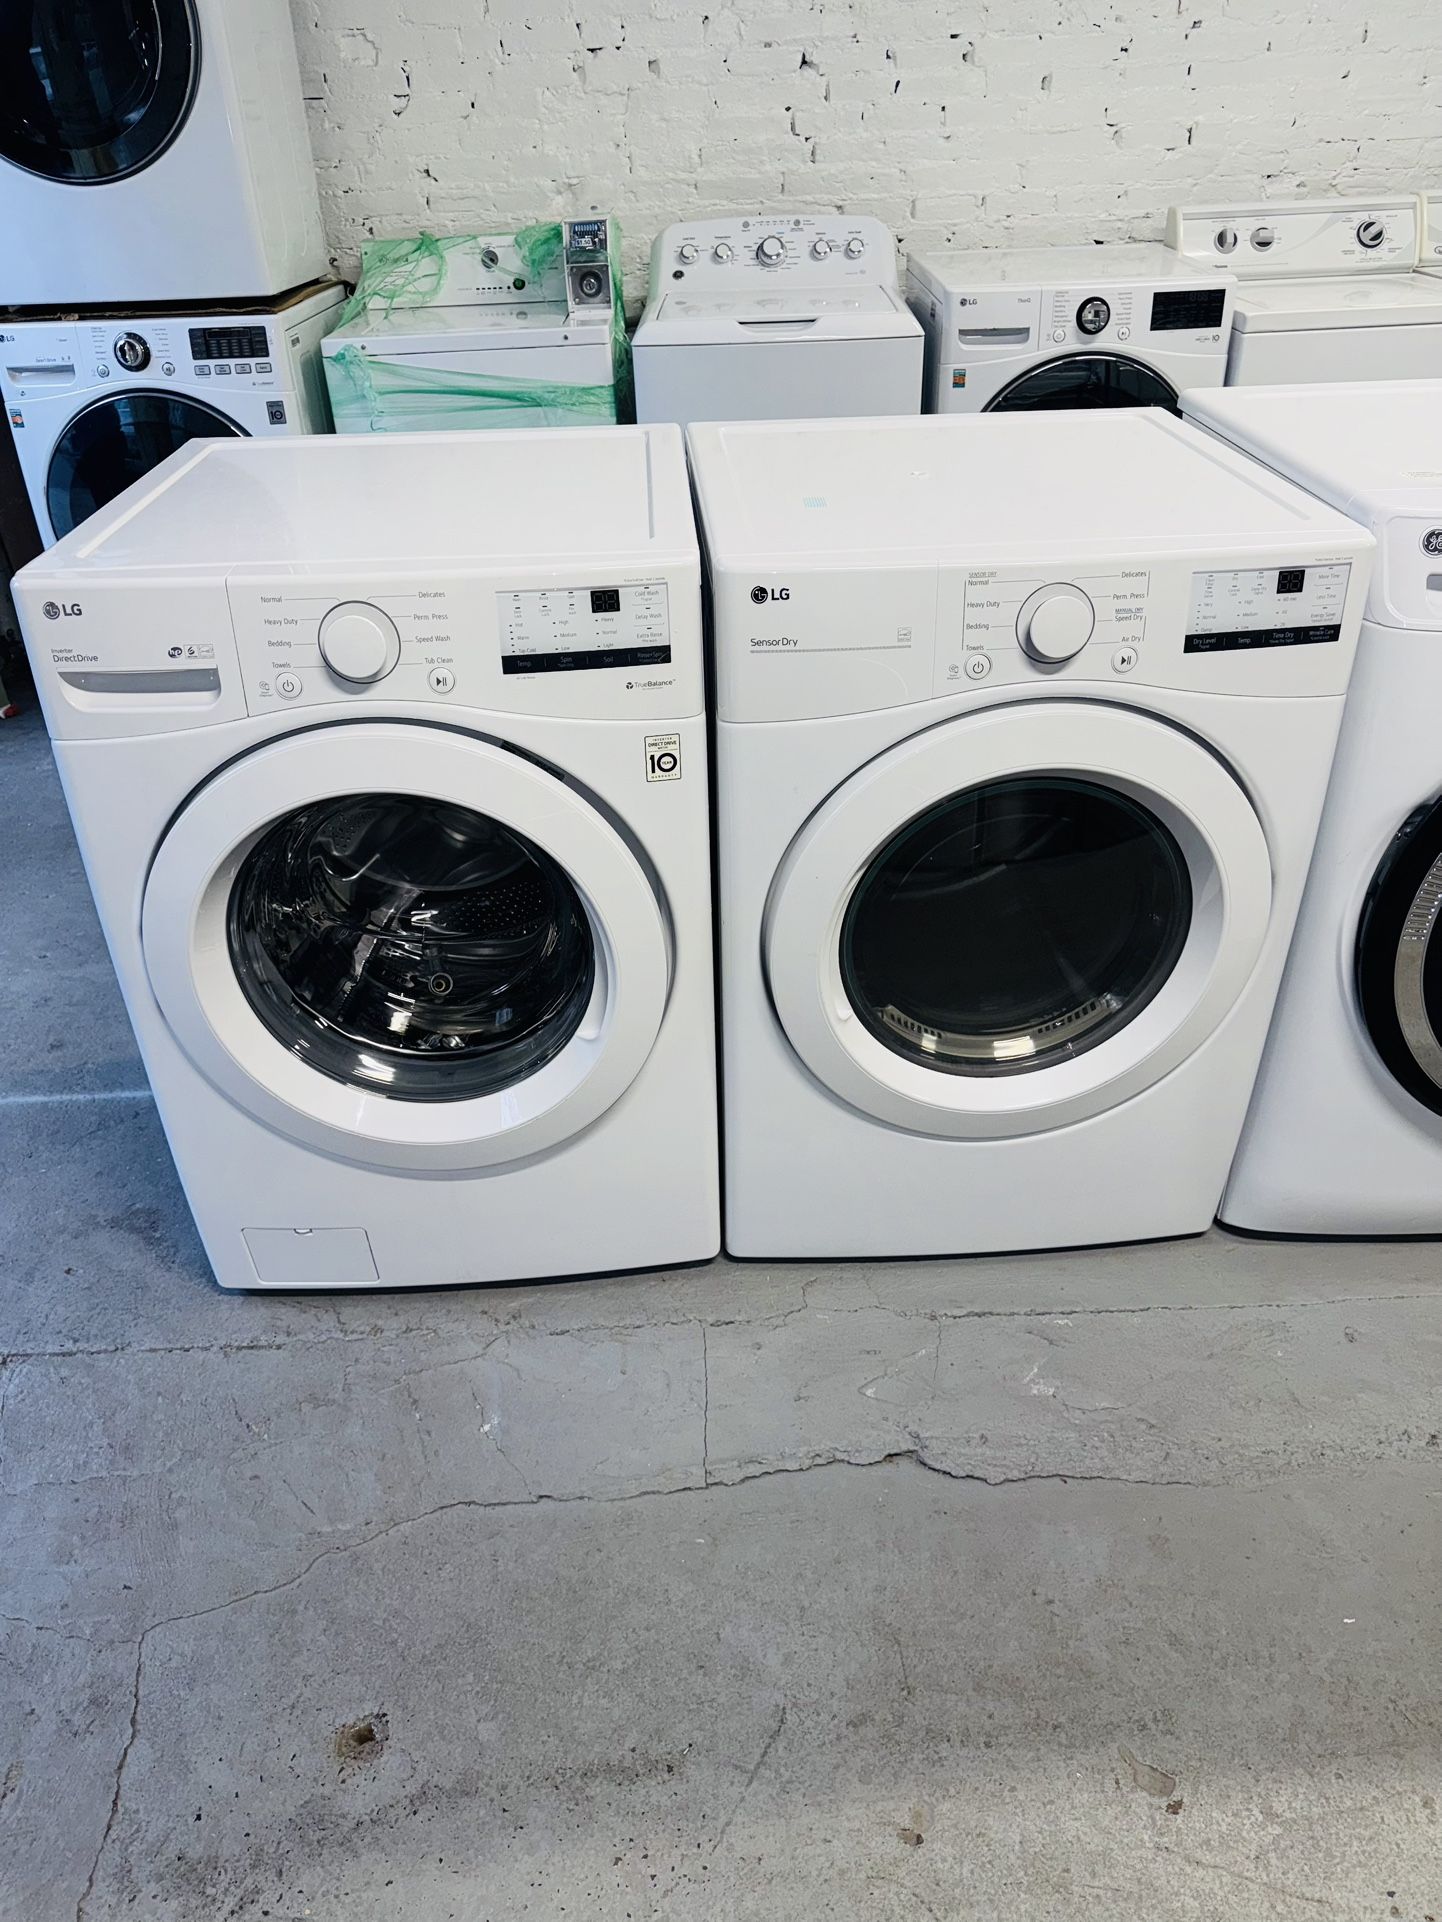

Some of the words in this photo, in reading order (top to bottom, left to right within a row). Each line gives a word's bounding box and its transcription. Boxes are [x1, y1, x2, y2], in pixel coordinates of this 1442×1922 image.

[967, 578, 990, 586] Normal
[770, 587, 790, 601] LG
[1130, 592, 1145, 600] Press
[260, 595, 283, 604] Normal
[966, 601, 985, 609] Heavy
[986, 600, 1001, 609] Duty
[62, 603, 82, 617] LG
[264, 618, 282, 626] Heavy
[283, 617, 298, 626] Duty
[1114, 614, 1132, 623] Speed
[1132, 613, 1144, 622] Dry
[965, 622, 990, 631] Bedding
[267, 639, 292, 648] Bedding
[415, 635, 434, 644] Speed
[1121, 635, 1129, 643] Air
[1130, 635, 1142, 643] Dry
[1203, 636, 1217, 644] Level
[50, 647, 73, 655] Inverter
[965, 643, 985, 651] Towels
[424, 656, 435, 664] Tub
[436, 656, 454, 664] Clean
[560, 655, 573, 664] Spin
[603, 655, 614, 663] Soil
[271, 661, 292, 669] Towels
[649, 752, 678, 774] 10
